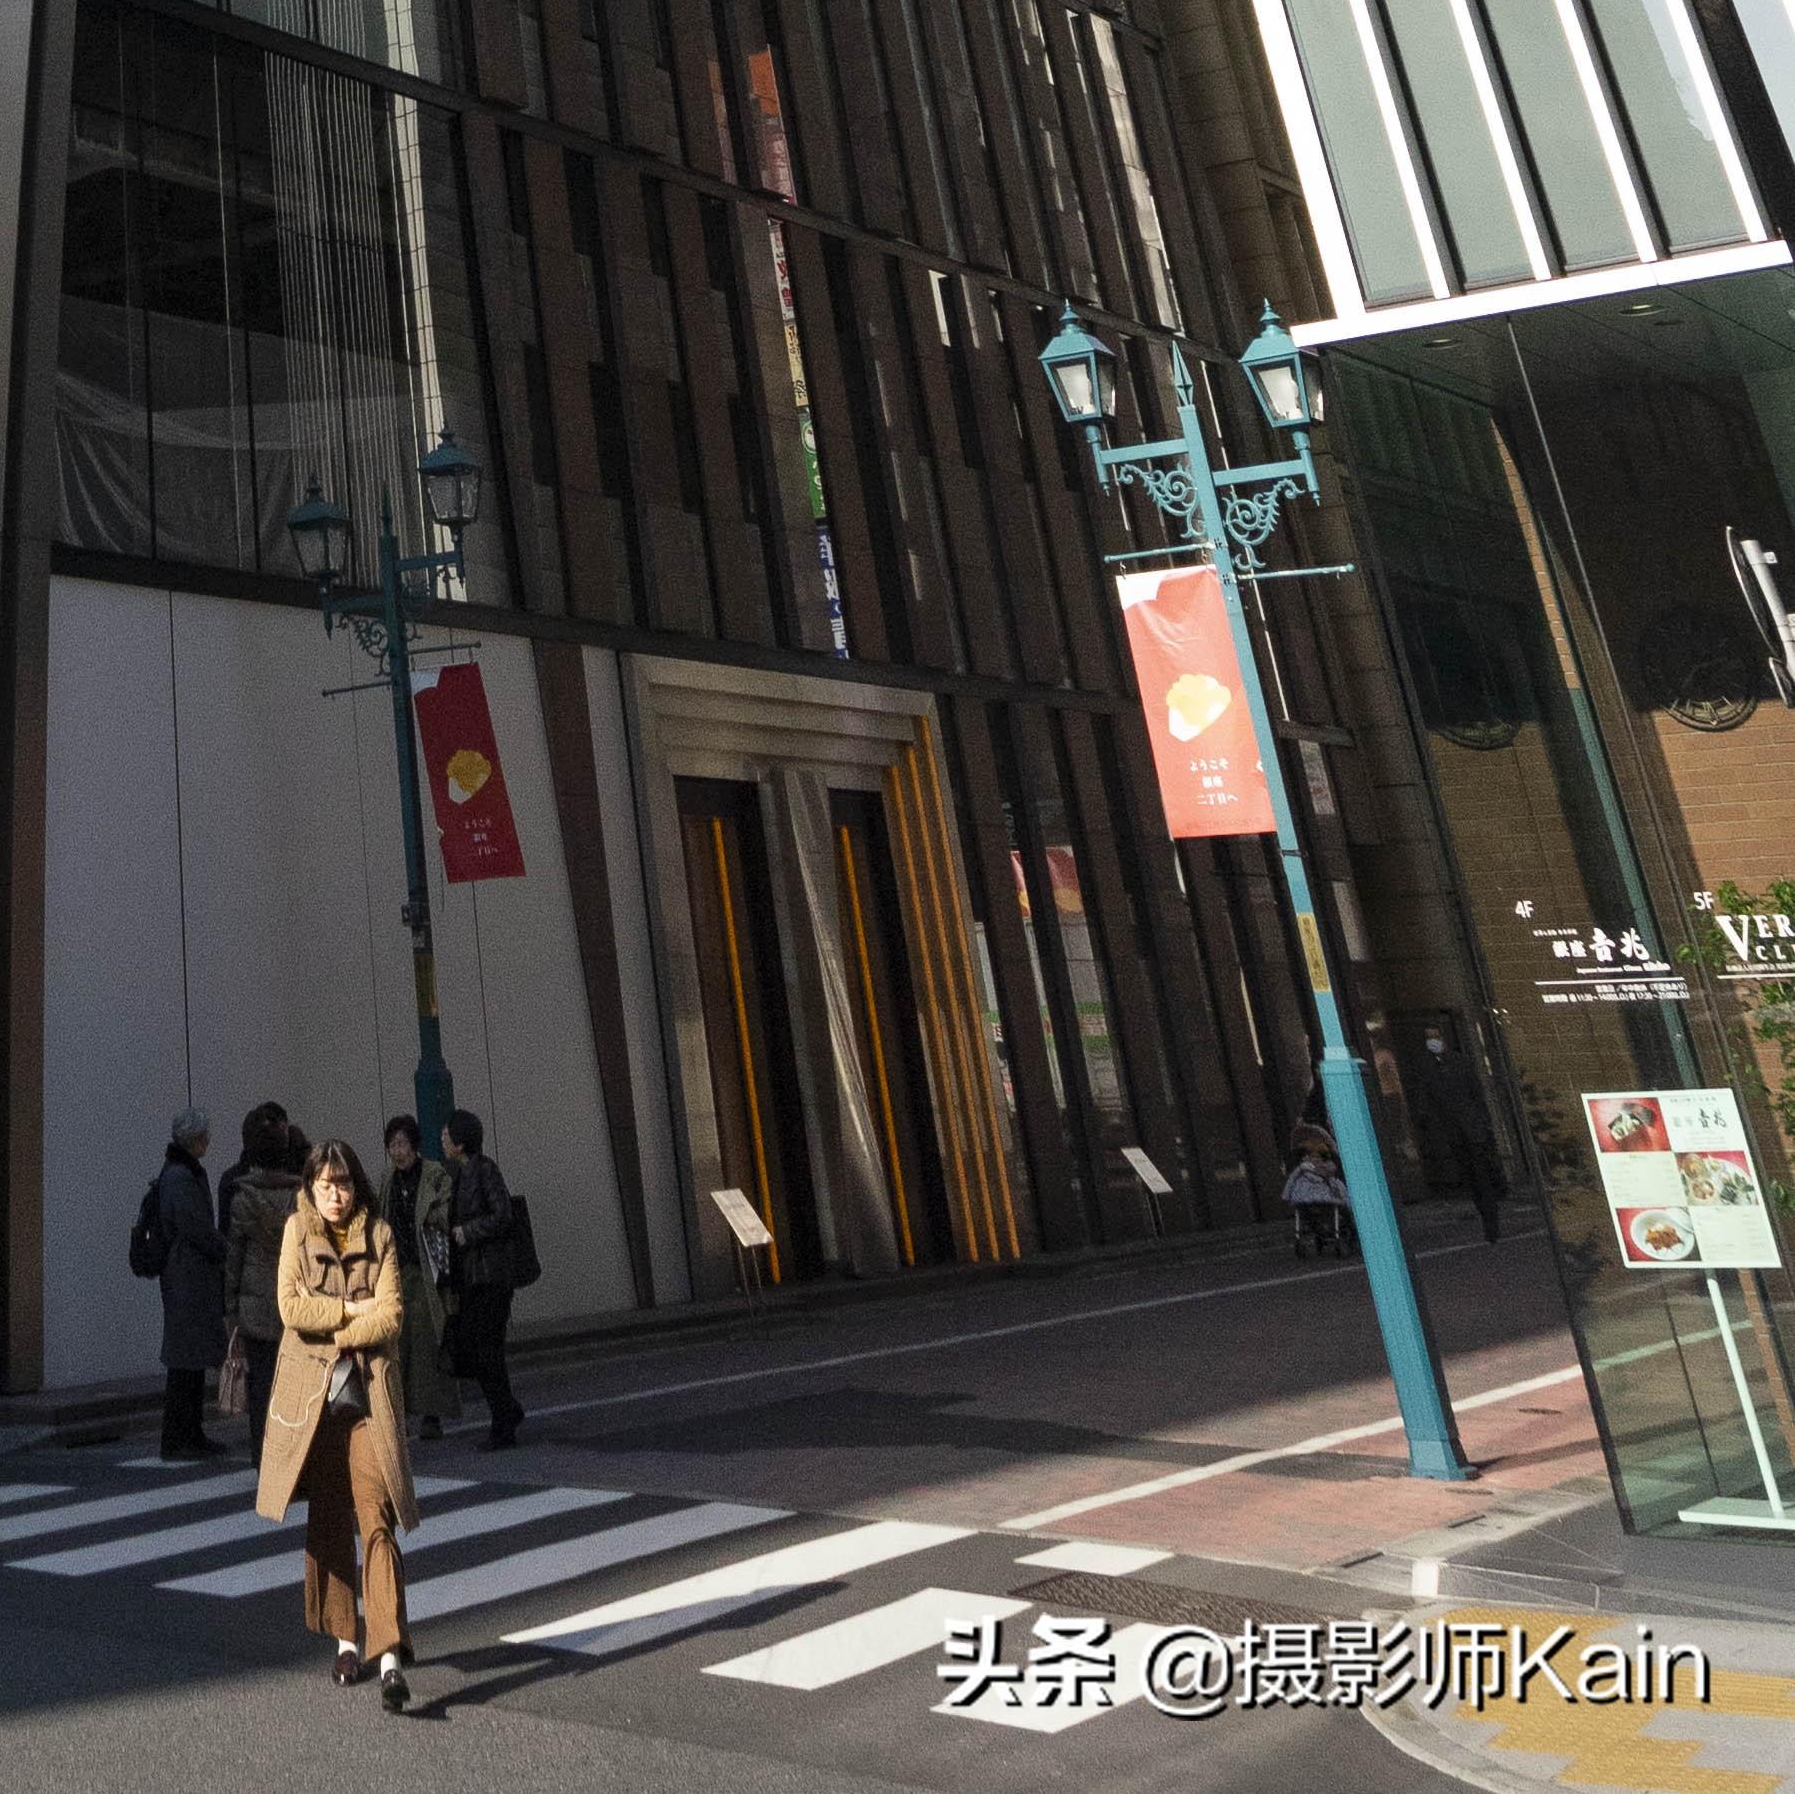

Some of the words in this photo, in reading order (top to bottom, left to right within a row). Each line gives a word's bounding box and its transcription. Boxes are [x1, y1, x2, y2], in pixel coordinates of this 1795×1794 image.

[1190, 758, 1229, 772] ようこそ
[1197, 792, 1238, 805] 二丁目へ
[1694, 891, 1714, 910] 5F
[1515, 900, 1534, 918] 4F
